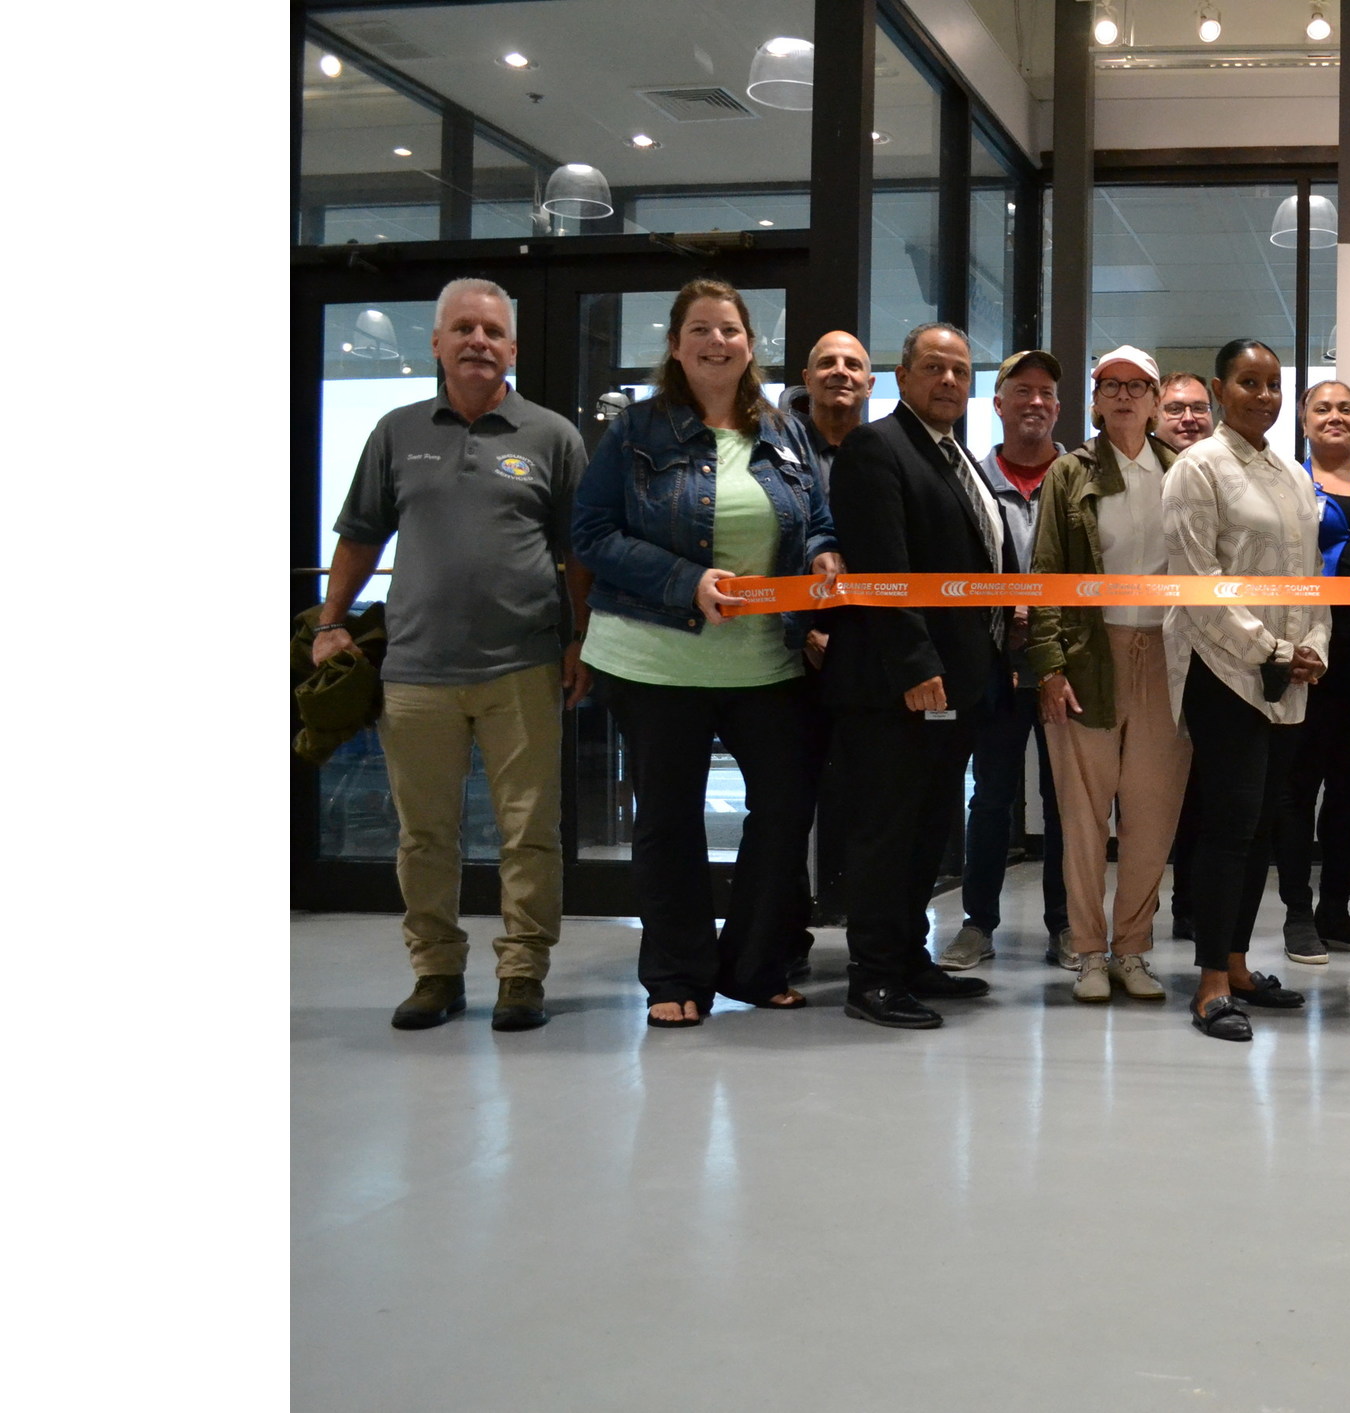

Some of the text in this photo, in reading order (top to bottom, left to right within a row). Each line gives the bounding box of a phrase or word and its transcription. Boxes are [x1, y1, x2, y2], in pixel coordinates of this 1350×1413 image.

[836, 582, 909, 591] ORANGE COUNTY
[738, 588, 775, 598] COUNTY
